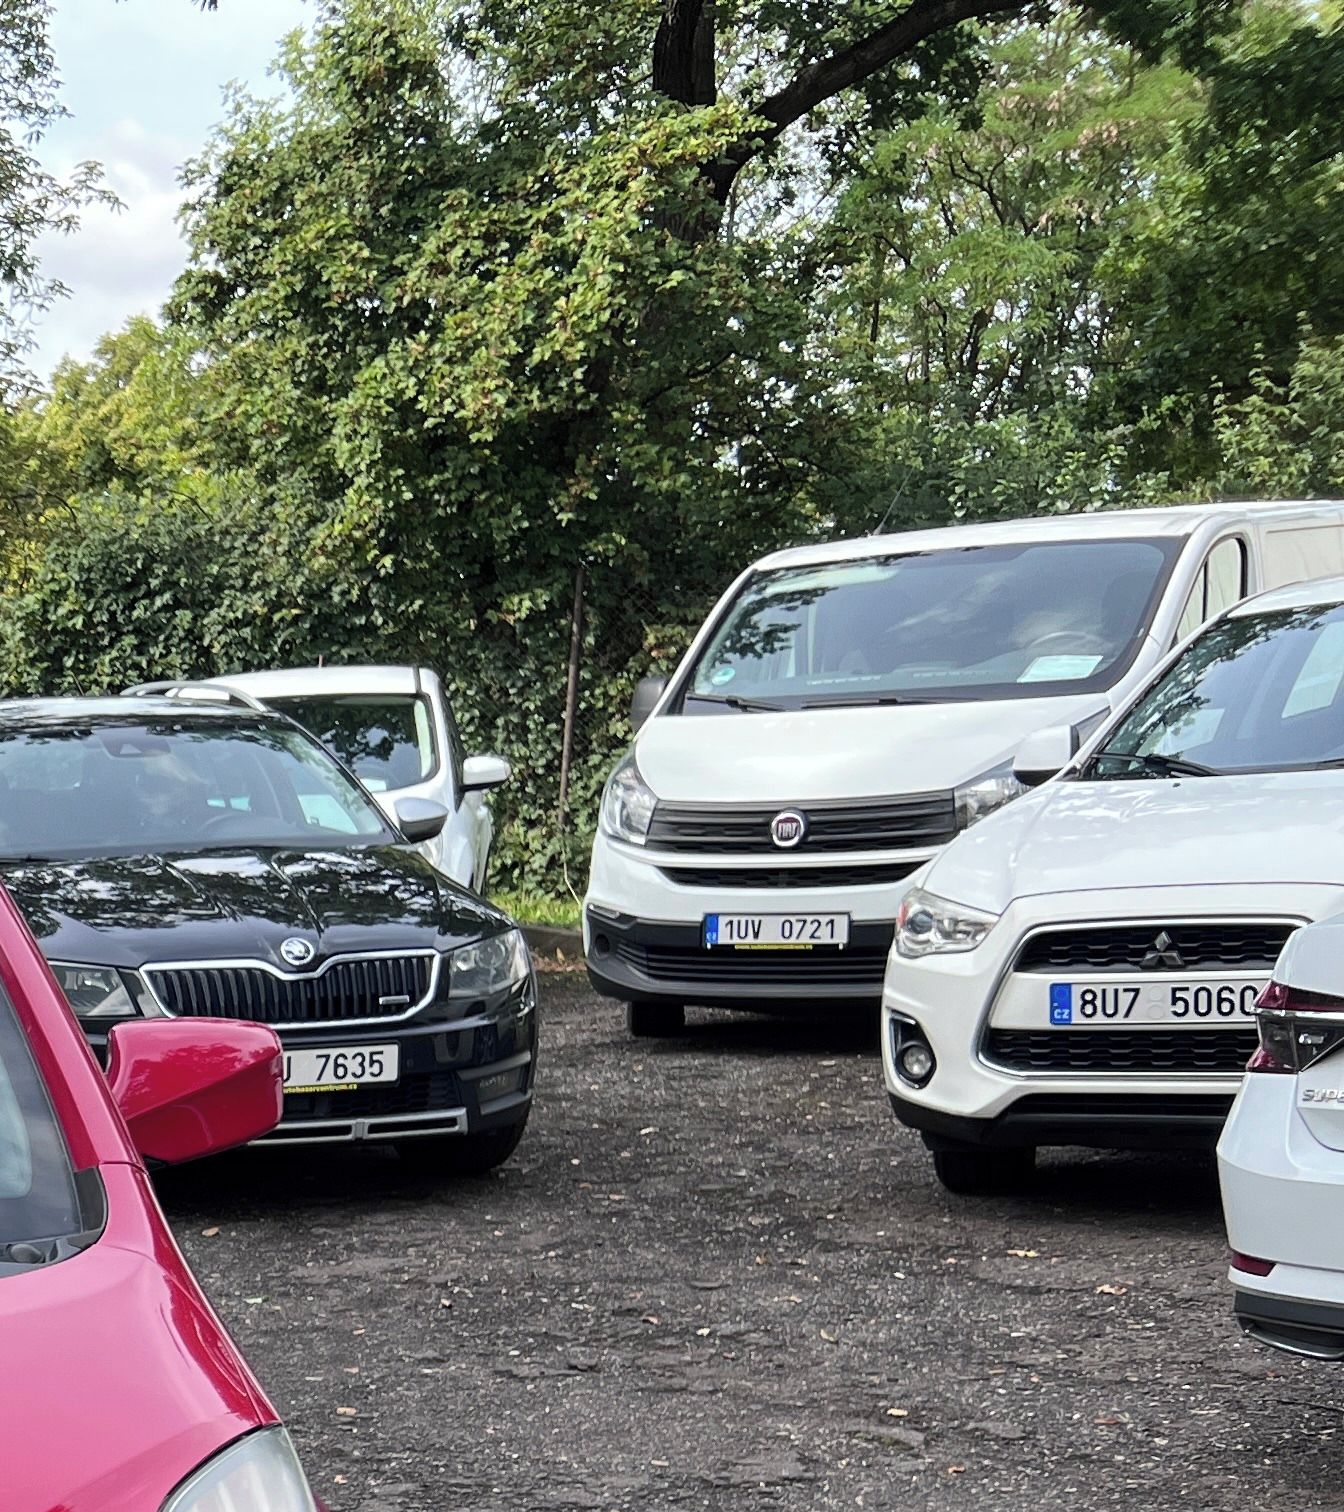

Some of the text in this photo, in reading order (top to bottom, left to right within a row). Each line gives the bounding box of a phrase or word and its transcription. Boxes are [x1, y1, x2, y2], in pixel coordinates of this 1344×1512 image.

[725, 919, 762, 940] 1UV
[781, 918, 835, 940] 0721
[1054, 984, 1259, 1019] CZ 8U7 5060
[316, 1050, 384, 1082] 7635
